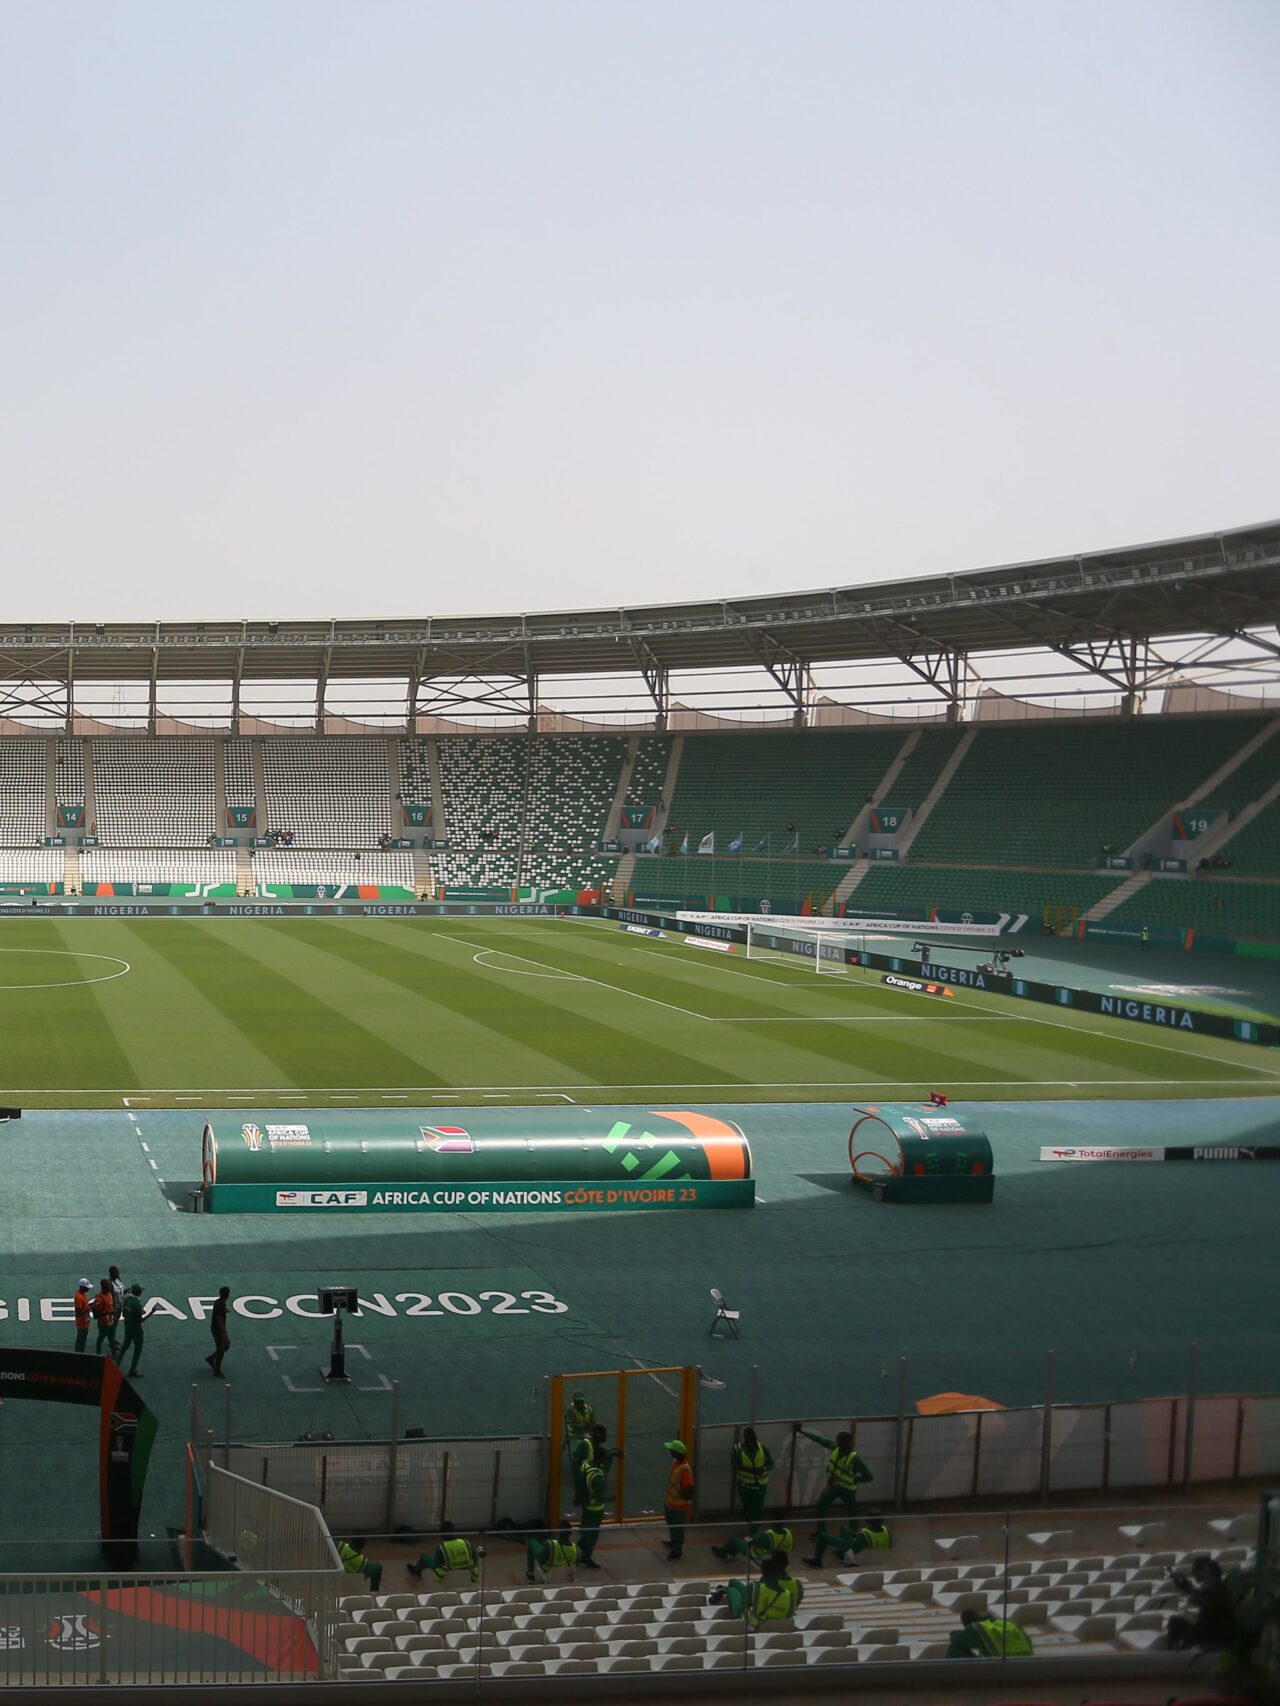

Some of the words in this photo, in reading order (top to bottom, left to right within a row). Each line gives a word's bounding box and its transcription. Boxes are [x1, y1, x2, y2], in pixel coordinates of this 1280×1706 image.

[65, 812, 77, 822] 14
[235, 813, 248, 823] 15
[410, 812, 424, 822] 16
[630, 813, 644, 823] 17
[882, 816, 898, 828] 18
[1189, 819, 1209, 832] 19
[94, 906, 148, 915] NIGERIA
[229, 906, 283, 915] NIGERIA
[363, 905, 417, 915] NIGERIA
[495, 905, 548, 914] NIGERIA
[618, 911, 648, 924] NIGERIA
[695, 924, 732, 940] NIGERIA
[911, 924, 939, 932] NATIONS
[792, 940, 840, 961] NIGERIA
[921, 963, 986, 988] NIGERIA
[886, 975, 923, 991] Orange
[1100, 996, 1194, 1030] NIGERIA
[1078, 1149, 1153, 1160] TotalEnergies
[1193, 1147, 1238, 1160] PUMA
[310, 1192, 358, 1205] CAF
[372, 1191, 431, 1205] AFRICA
[433, 1191, 465, 1205] CUP
[467, 1191, 490, 1205] OF
[492, 1190, 562, 1205] NATIONS
[563, 1187, 604, 1205] CÔTE
[607, 1189, 675, 1203] D'IVOIRE
[679, 1188, 697, 1201] 23
